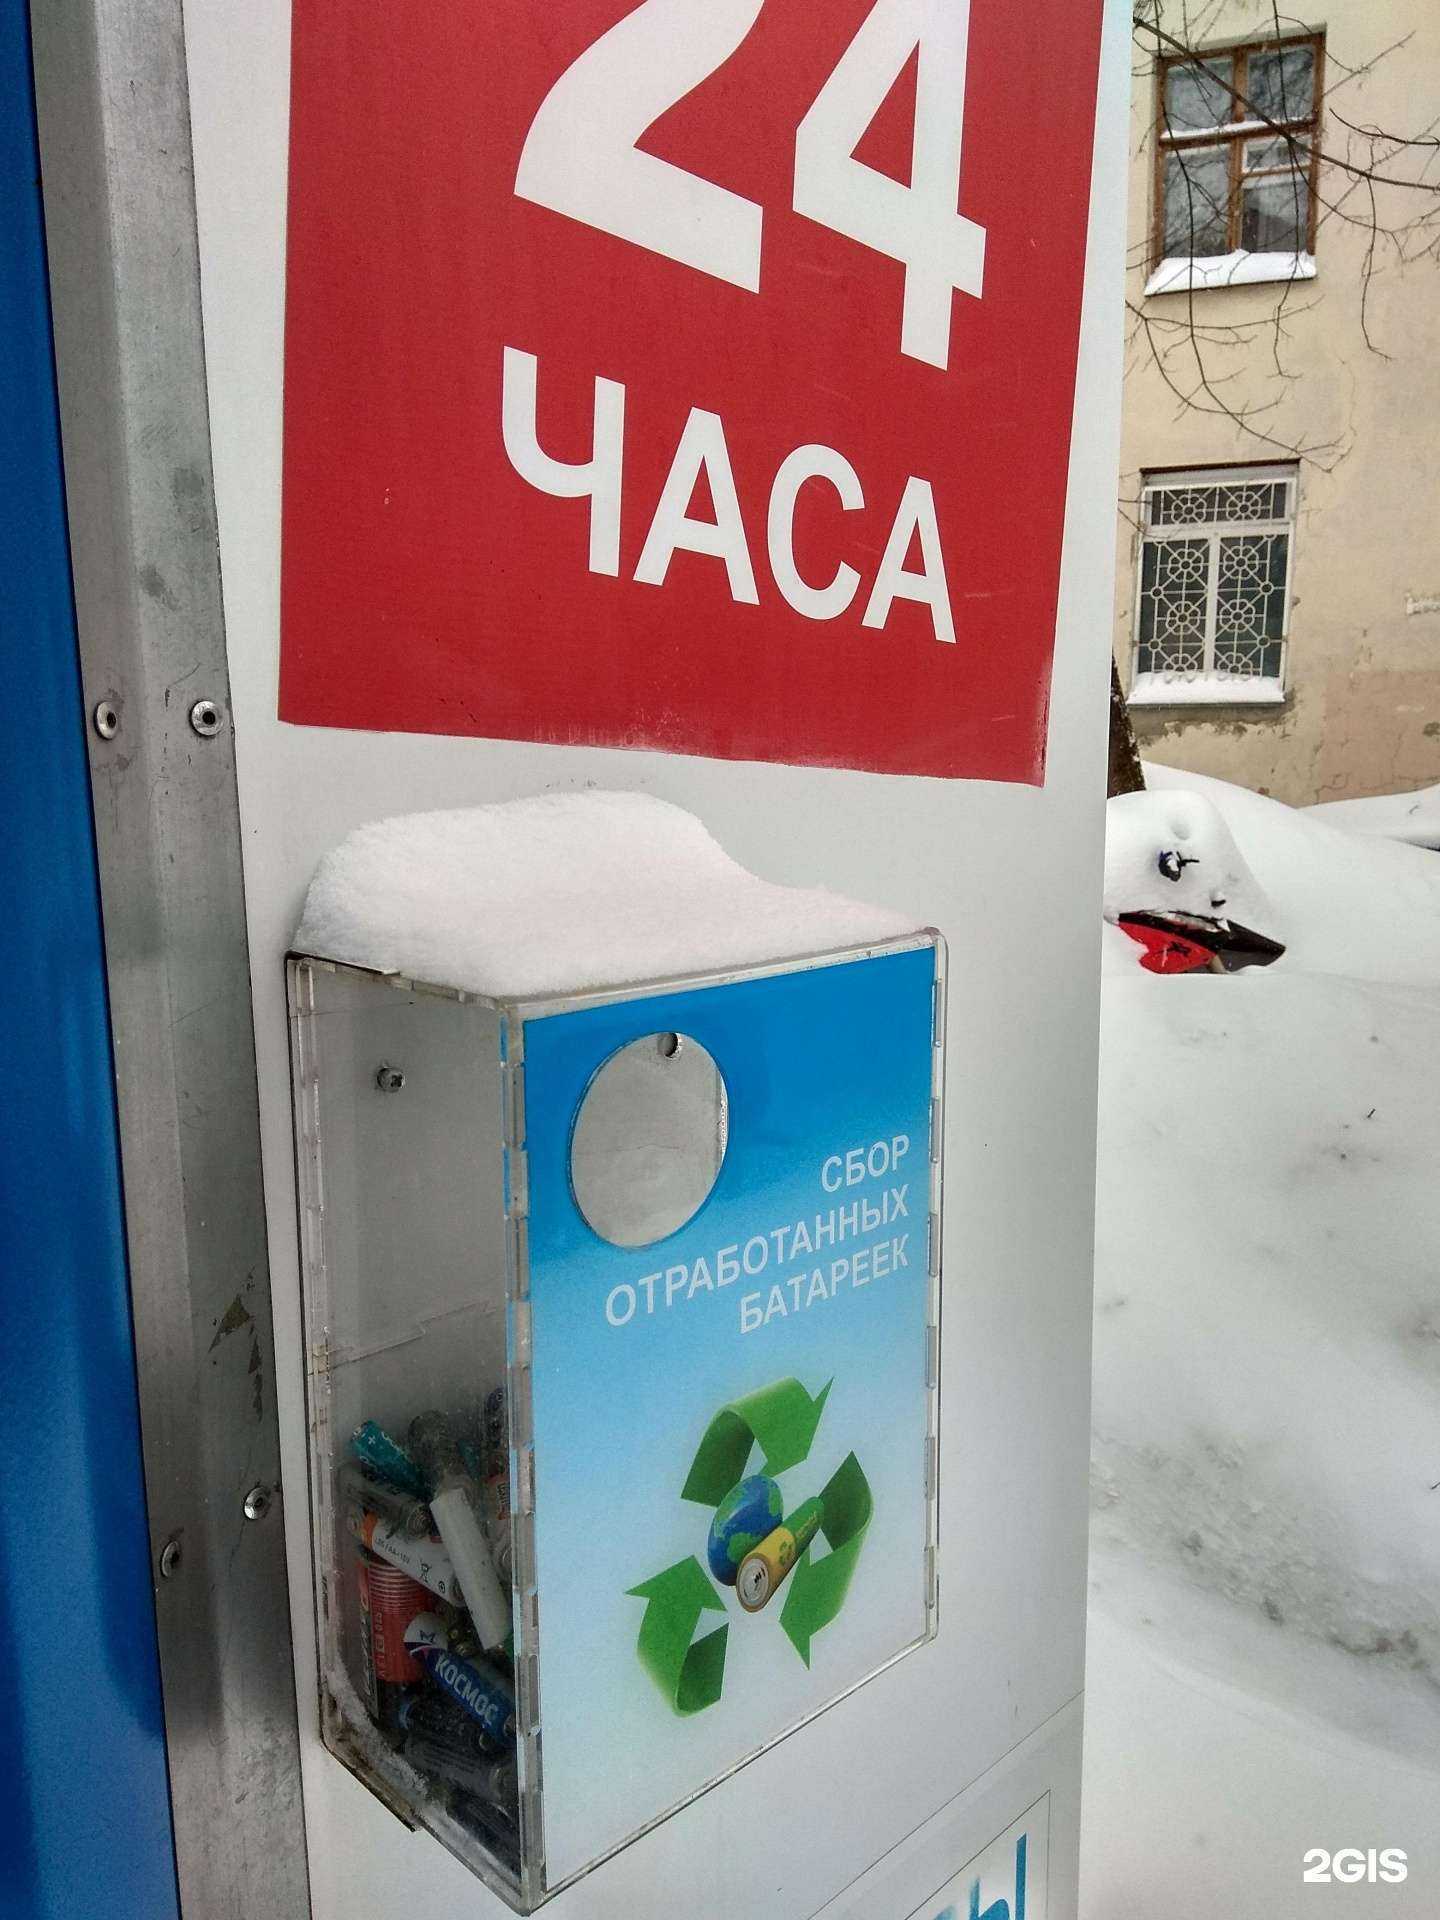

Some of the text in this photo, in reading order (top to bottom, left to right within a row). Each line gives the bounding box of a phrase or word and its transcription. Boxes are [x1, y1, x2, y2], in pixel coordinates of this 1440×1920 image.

[513, 0, 987, 371] 24
[501, 345, 957, 644] ЧАСА
[821, 1134, 910, 1192] СБОР
[605, 1183, 909, 1326] ОТРАБОТАННЫХ
[739, 1232, 909, 1334] БАТАРЕЕК
[434, 1654, 499, 1727] КОСМОС
